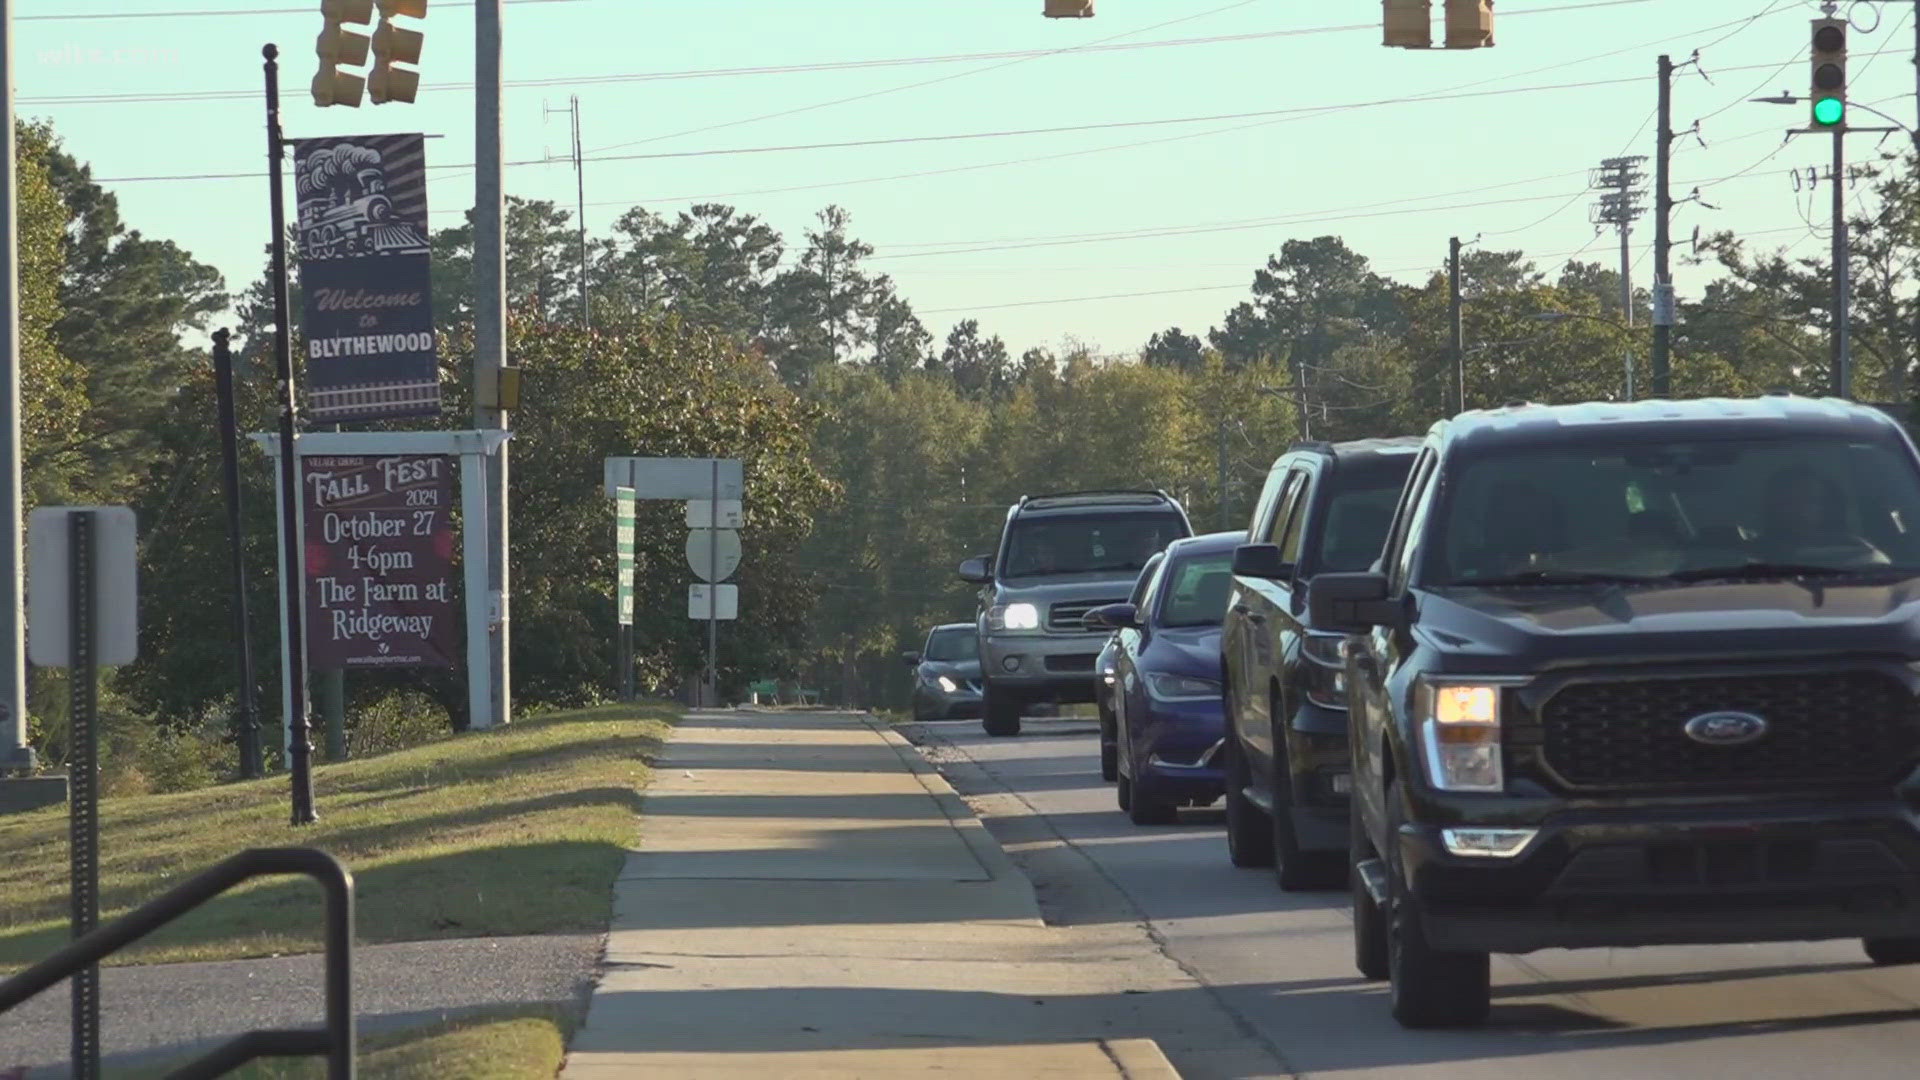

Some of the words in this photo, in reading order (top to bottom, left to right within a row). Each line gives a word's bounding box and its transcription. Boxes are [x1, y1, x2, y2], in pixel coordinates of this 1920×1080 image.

[313, 287, 421, 311] Welcome
[359, 314, 378, 328] to
[309, 332, 432, 359] BLYTHEWOOD
[306, 471, 370, 508] FALL
[376, 457, 444, 493] FEST
[406, 489, 438, 506] 2024
[323, 511, 406, 543] October
[413, 510, 435, 536] 27
[347, 544, 414, 576] 4-6pm
[316, 577, 356, 608] The
[363, 577, 419, 607] Farm
[425, 577, 449, 603] at
[332, 608, 434, 640] Ridgeway
